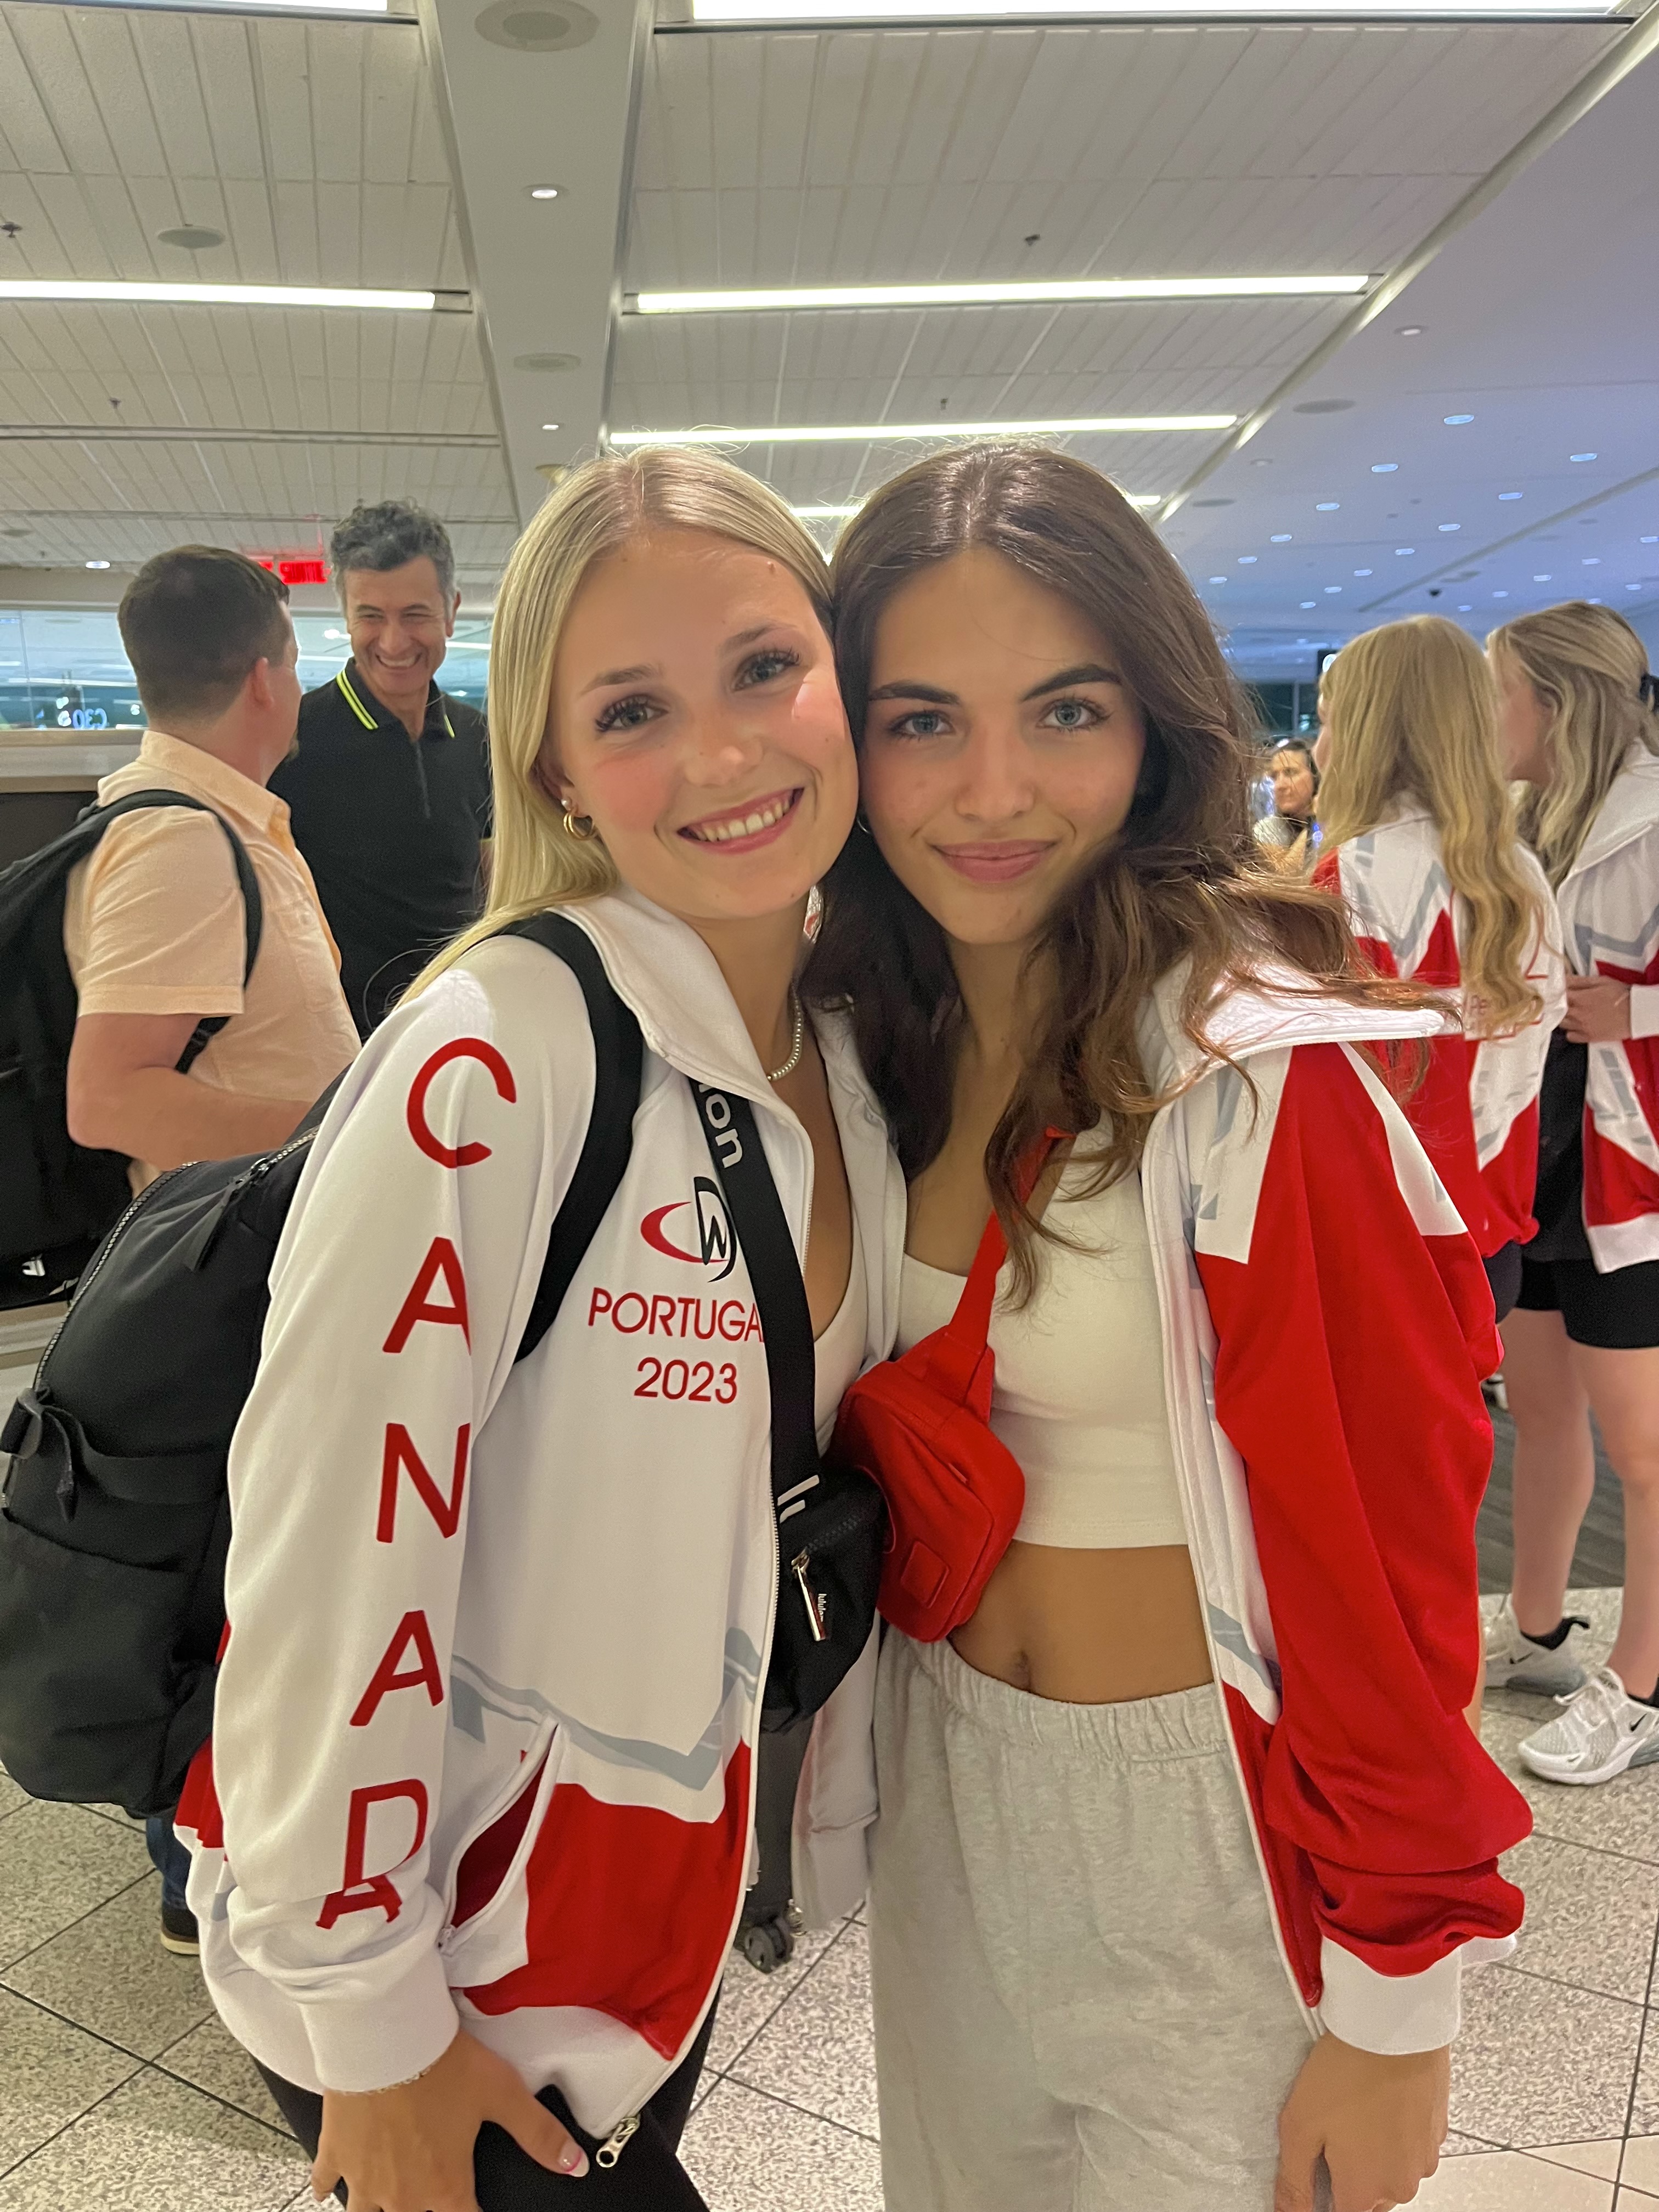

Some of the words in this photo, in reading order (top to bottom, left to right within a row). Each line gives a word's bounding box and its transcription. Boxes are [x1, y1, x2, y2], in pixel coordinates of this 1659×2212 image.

[588, 1288, 764, 1342] PORTUGA
[634, 1357, 737, 1404] 2023
[316, 1037, 516, 1929] CANADA
